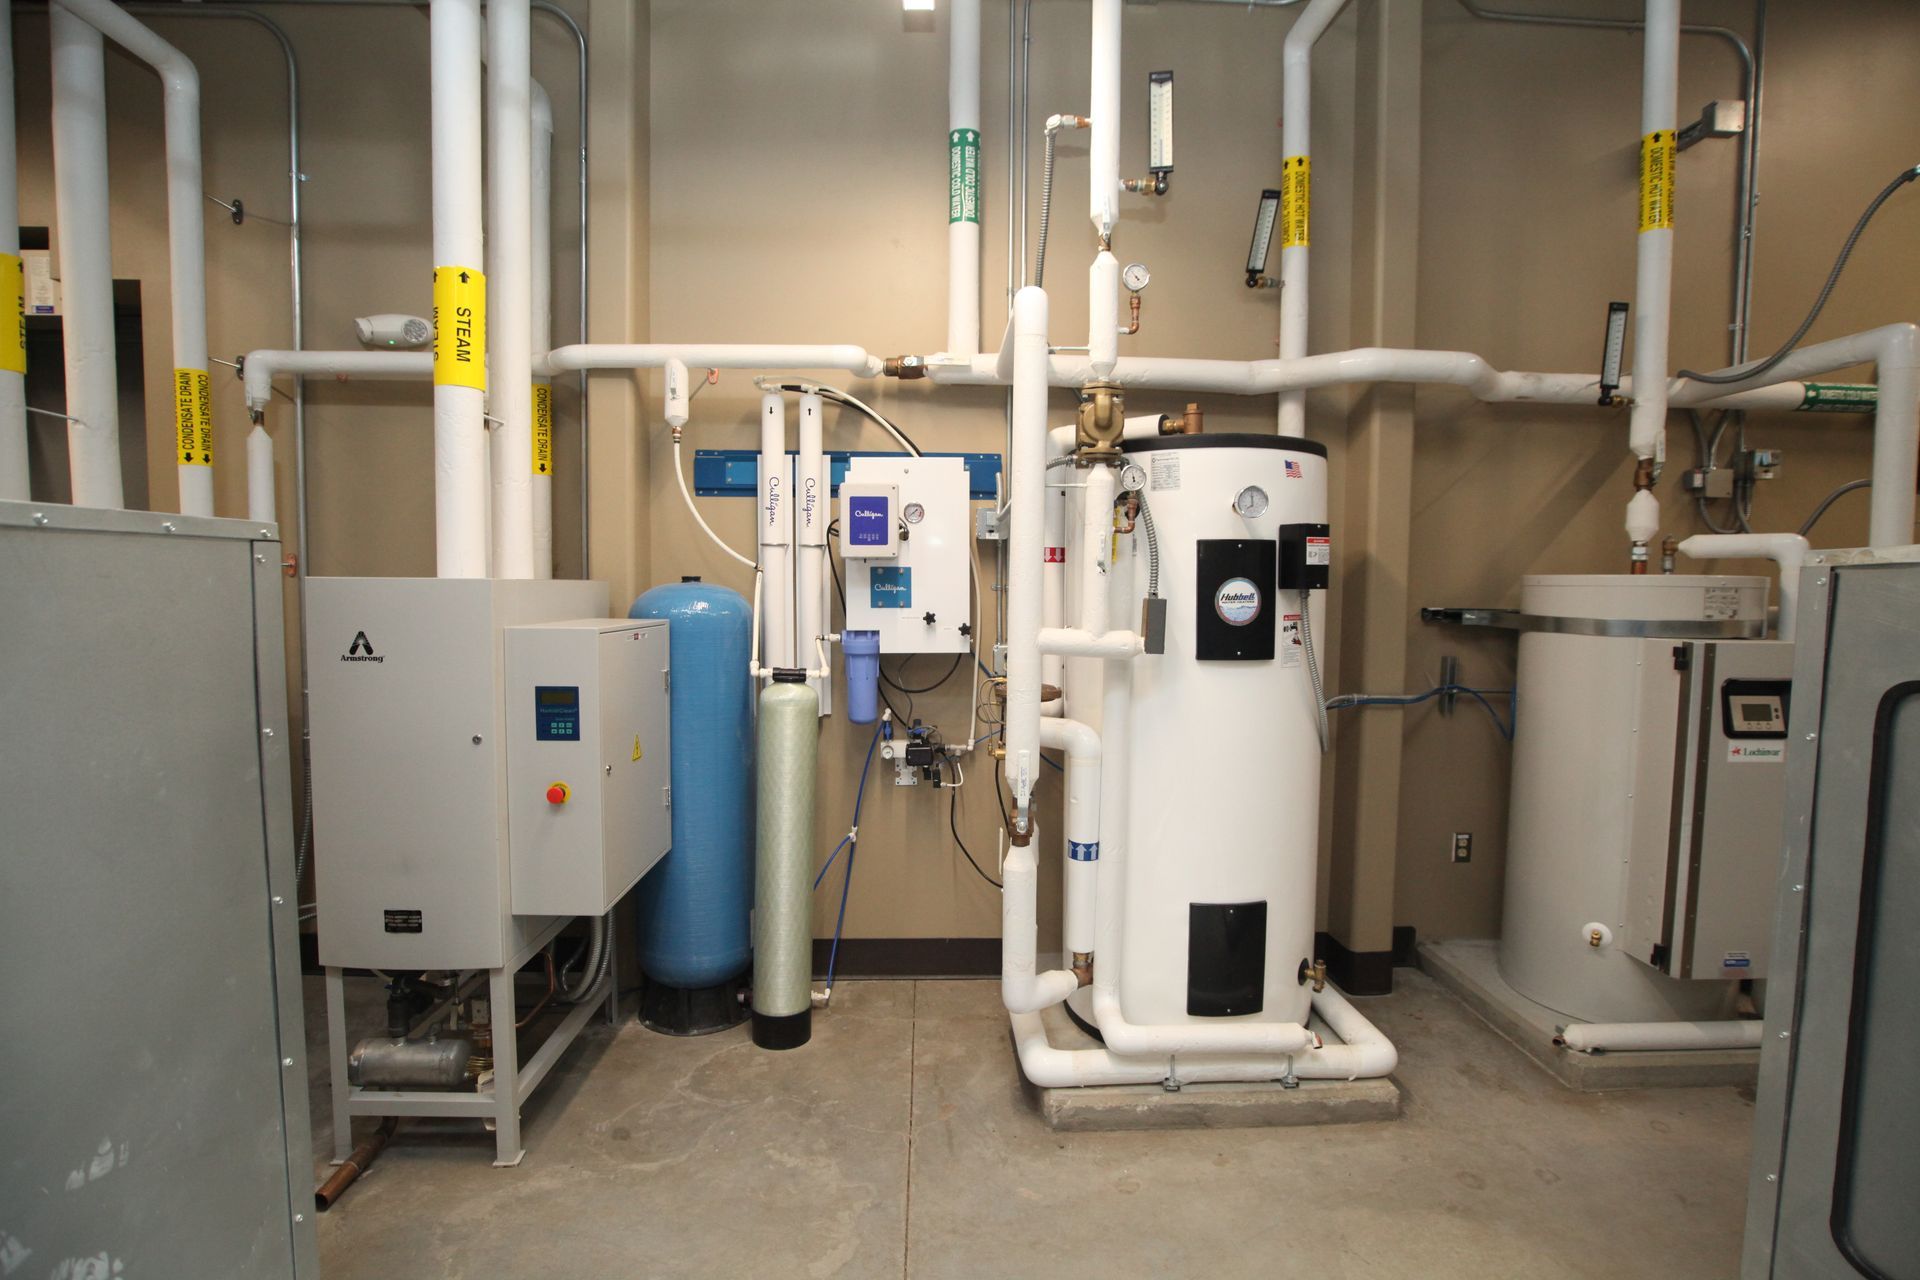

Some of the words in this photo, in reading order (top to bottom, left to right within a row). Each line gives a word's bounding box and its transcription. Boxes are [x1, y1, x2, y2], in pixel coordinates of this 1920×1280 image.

[952, 146, 961, 178] DOMESTIC
[965, 145, 975, 168] WATER
[1649, 147, 1664, 183] DOMESTIC
[952, 178, 961, 195] COLD
[965, 168, 975, 186] COLD
[1295, 171, 1305, 203] DOMESTIC
[952, 196, 961, 218] WATER
[965, 185, 975, 218] DOMESTIC
[1295, 204, 1305, 217] HOT
[1649, 200, 1662, 224] WATER
[1295, 219, 1305, 241] WATER
[456, 307, 472, 363] STEAM
[179, 370, 192, 396] DRAIN
[198, 374, 211, 427] CONDENSATE
[537, 387, 548, 435] CONDENSATE
[181, 397, 195, 451] CONDENSATE
[201, 427, 211, 452] DRAIN
[538, 436, 548, 462] DRAIN
[765, 476, 780, 526] Culligan
[802, 477, 816, 528] Culligan
[854, 509, 884, 520] Culligan
[874, 583, 907, 594] Culligan
[1221, 592, 1256, 601] Hubbell
[340, 654, 385, 664] Armstrong
[1743, 747, 1781, 756] Lochinvar
